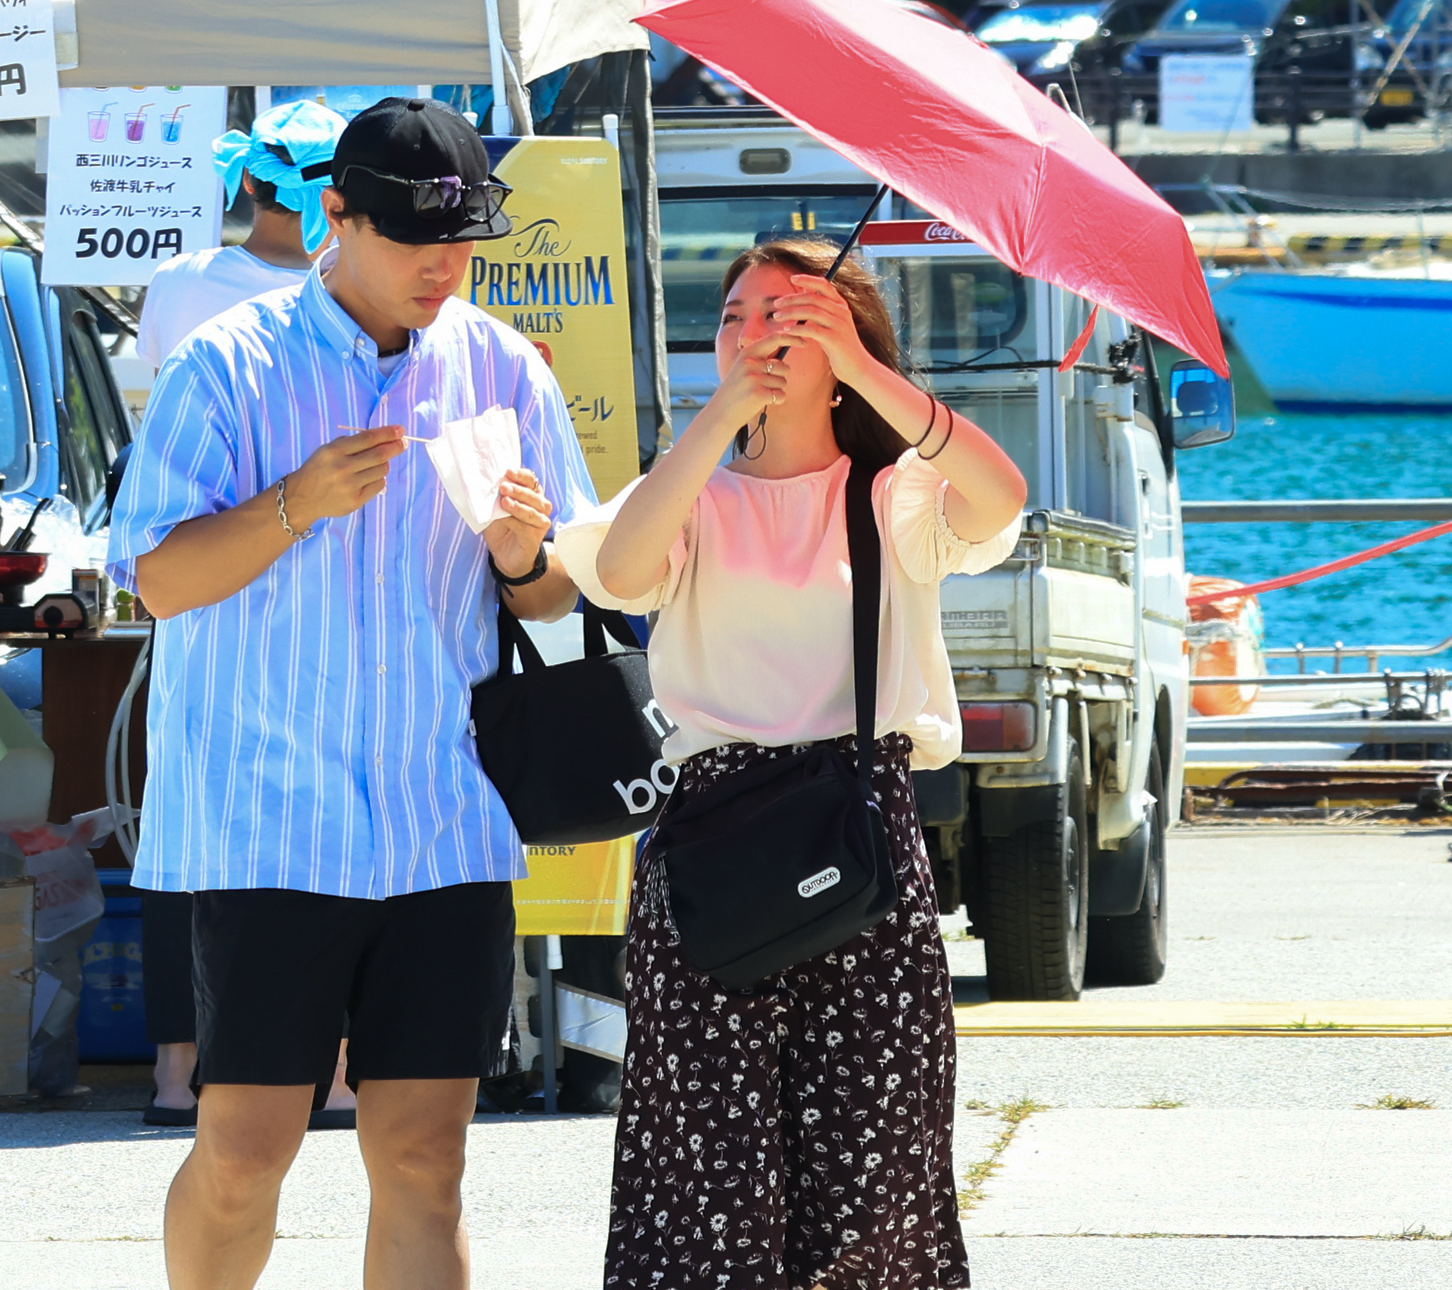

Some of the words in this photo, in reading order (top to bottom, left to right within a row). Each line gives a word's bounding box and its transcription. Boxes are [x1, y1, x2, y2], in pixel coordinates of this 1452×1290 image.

[76, 154, 192, 169] 西三川リンゴジュース
[90, 179, 176, 194] 佐渡牛乳チャイ
[59, 204, 202, 218] パッションフルーツジュース
[75, 227, 183, 259] 500円
[470, 255, 615, 307] PREMIUM
[513, 311, 563, 334] MALT'S
